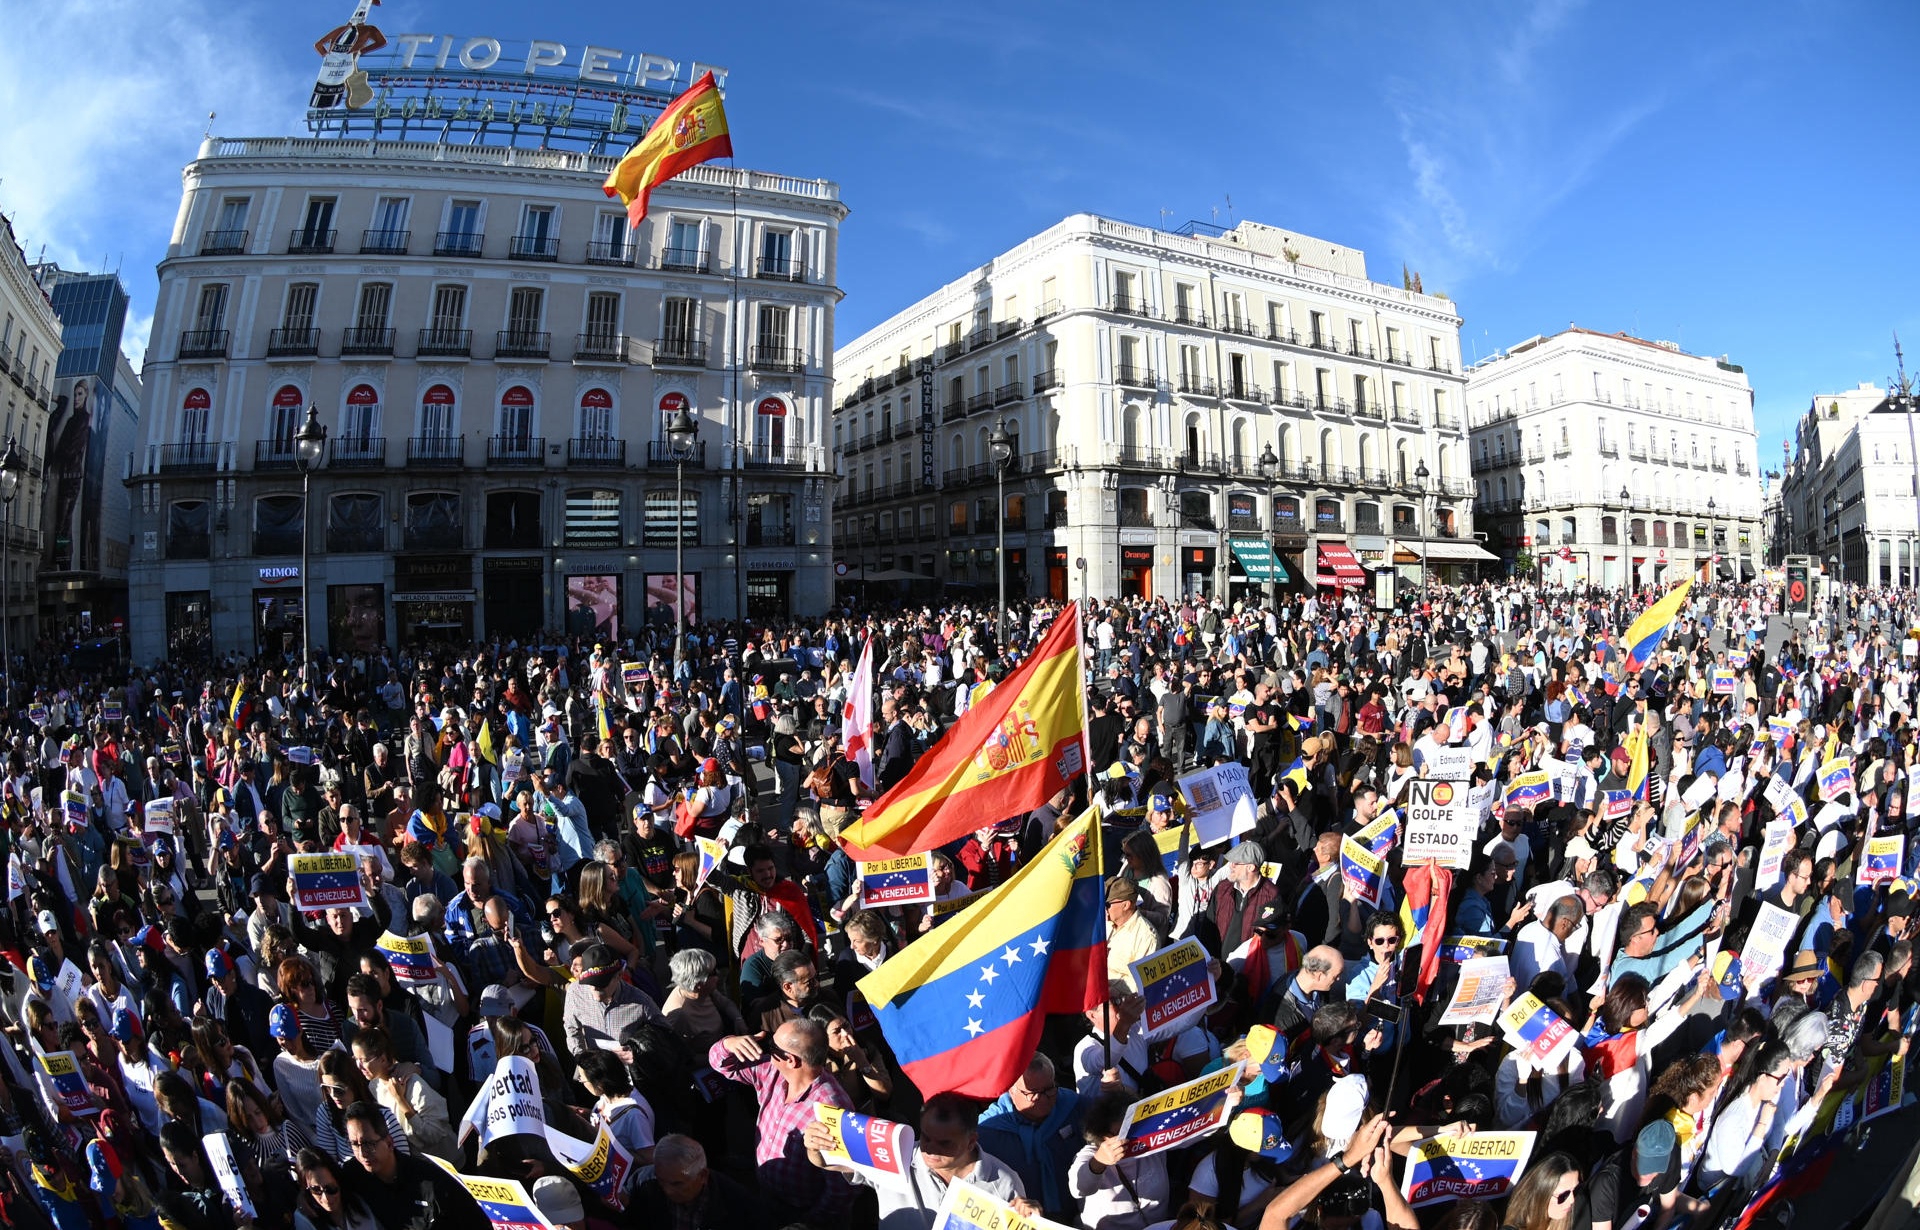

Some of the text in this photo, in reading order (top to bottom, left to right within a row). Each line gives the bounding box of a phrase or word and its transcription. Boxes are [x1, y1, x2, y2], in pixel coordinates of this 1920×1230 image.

[398, 34, 501, 71] TIO
[379, 77, 416, 88] SOL
[424, 77, 449, 88] DE
[375, 87, 573, 130] GONZALEZ
[923, 363, 934, 486] HOTEL EUROPA
[1233, 541, 1268, 549] CHANGE
[1125, 550, 1150, 560] Orange
[1359, 550, 1384, 560] ELATO
[259, 567, 299, 578] PRIMOR
[1246, 564, 1282, 573] CAMBO
[400, 593, 466, 601] HELADOS ITALIANOS
[1439, 755, 1466, 765] Edmundo
[1522, 774, 1546, 785] LIBERTAD
[1412, 808, 1454, 821] GOLPE
[1409, 832, 1459, 845] ESTADO
[297, 857, 352, 871] Por la LIBERTAD
[867, 856, 922, 872] Por la LIBERTAD
[1355, 853, 1380, 873] LIBERTAD
[304, 888, 357, 902] de VENEZUELA
[879, 885, 925, 899] VENEZUELA
[937, 903, 949, 913] Por
[949, 901, 955, 910] la
[392, 940, 424, 952] LIBERTAD
[1143, 943, 1199, 981] Por la LIBERTAD
[392, 966, 431, 977] ENEZUELA
[63, 972, 76, 996] mundo
[1152, 986, 1206, 1022] de VENEZUELA
[1511, 999, 1538, 1024] Por la
[1539, 1038, 1551, 1051] de
[490, 1068, 535, 1101] bertad
[1140, 1073, 1229, 1118] Por la LIBERTAD
[508, 1099, 544, 1123] políticos
[1131, 1112, 1215, 1153] de VENEZUELA
[874, 1147, 891, 1163] de
[1424, 1139, 1516, 1157] Por la LIBERTAD
[466, 1183, 514, 1202] BERTAD
[1415, 1180, 1500, 1199] de VENEZUELA
[962, 1197, 986, 1221] Por
[987, 1209, 1001, 1230] la
